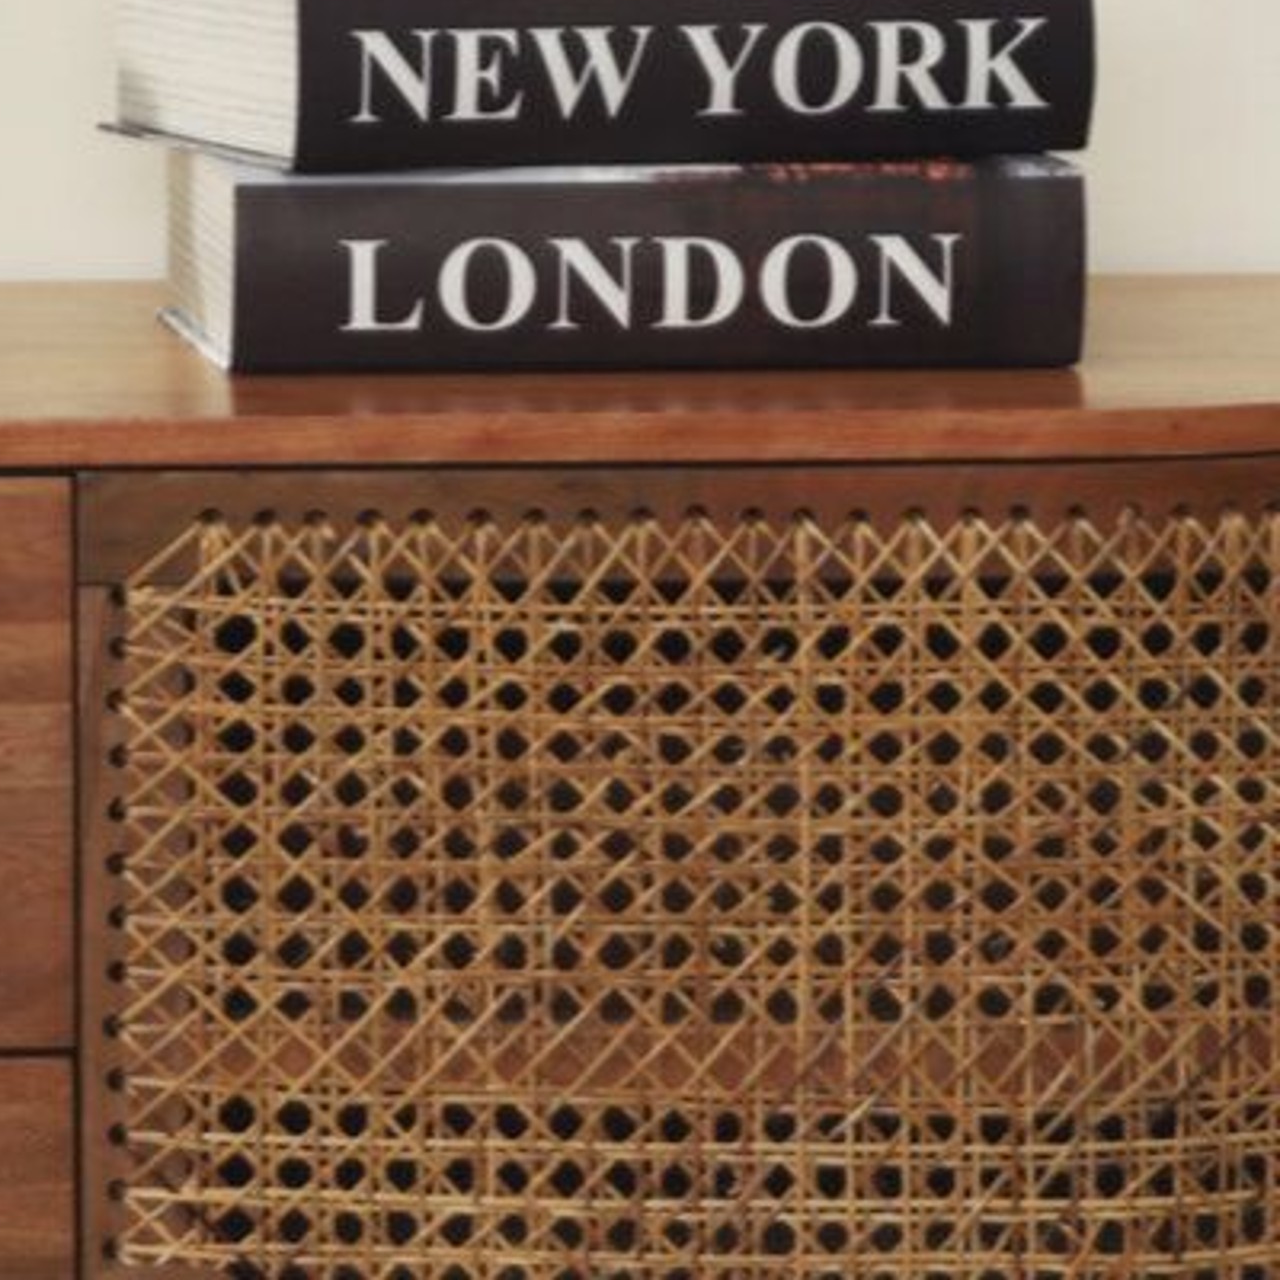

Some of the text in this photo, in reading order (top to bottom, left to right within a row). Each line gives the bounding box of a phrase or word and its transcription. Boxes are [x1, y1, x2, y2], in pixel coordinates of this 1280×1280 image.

[350, 16, 1049, 123] NEW YORK
[338, 232, 963, 332] LONDON
